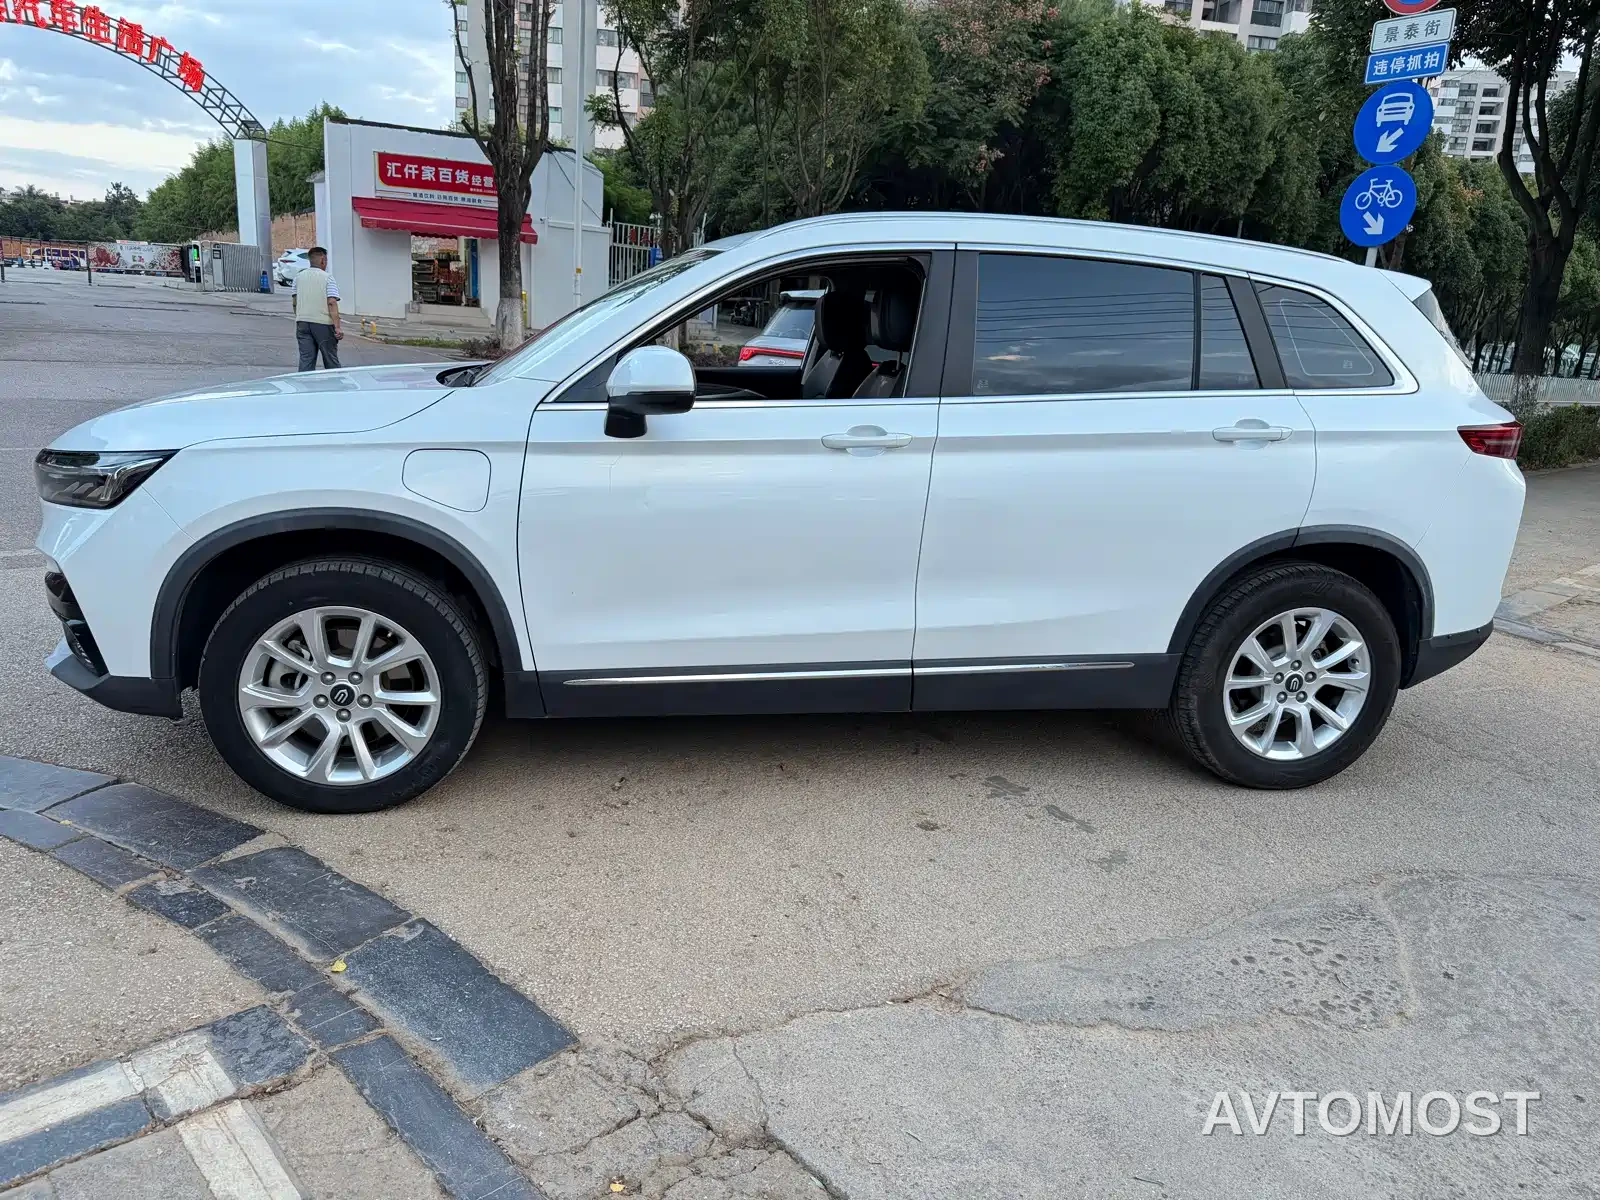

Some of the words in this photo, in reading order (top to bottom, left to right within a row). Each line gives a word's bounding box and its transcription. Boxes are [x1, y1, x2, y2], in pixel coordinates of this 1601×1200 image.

[1383, 19, 1441, 43] 景泰街
[1372, 51, 1440, 76] 违停抓拍
